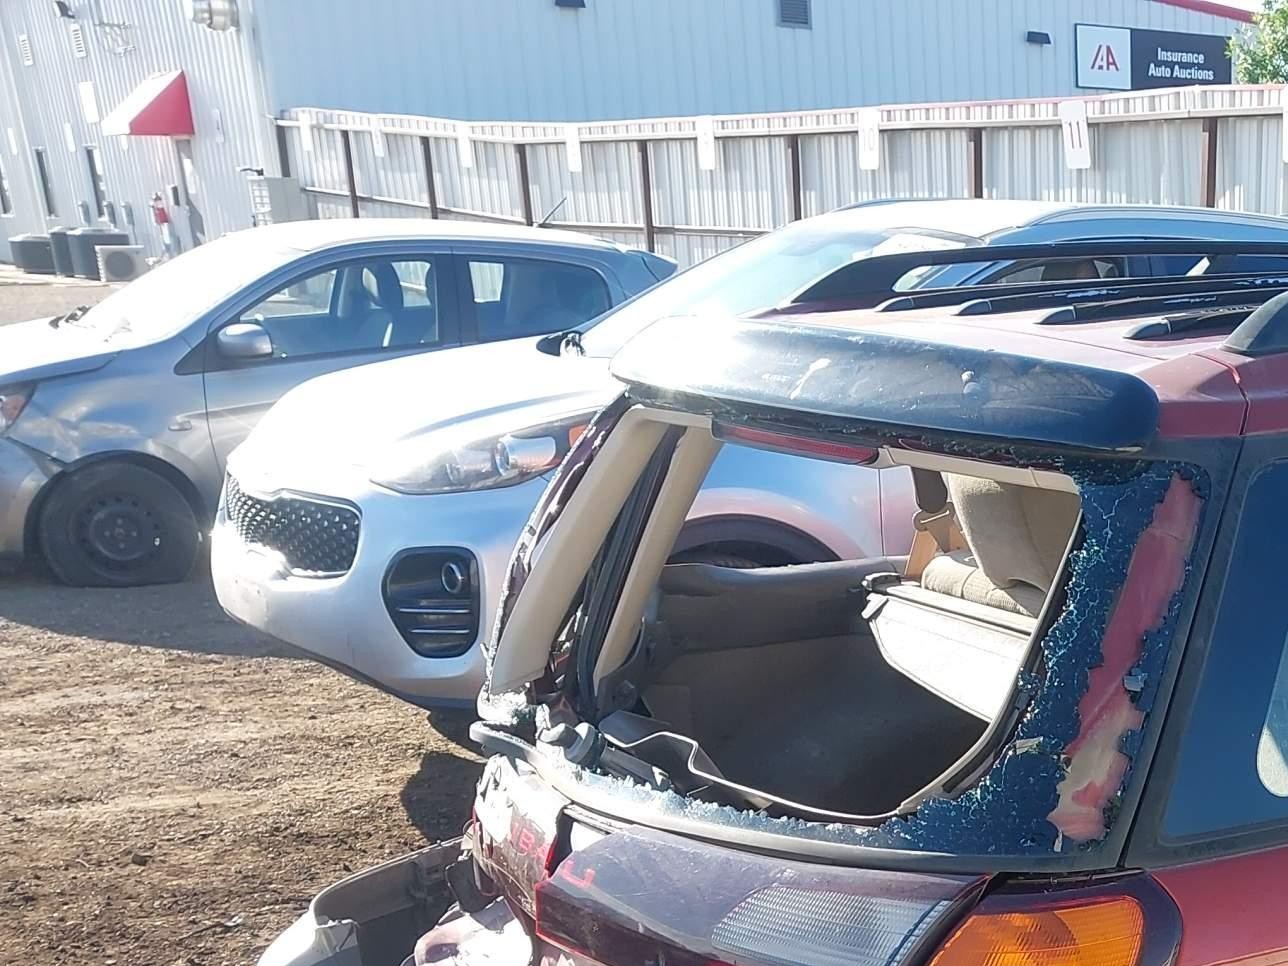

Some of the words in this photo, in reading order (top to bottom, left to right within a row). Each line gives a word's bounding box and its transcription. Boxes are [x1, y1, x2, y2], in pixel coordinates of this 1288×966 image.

[1157, 47, 1204, 64] Insurance
[1148, 63, 1171, 78] Auto
[1173, 65, 1214, 81] Auctions
[1068, 120, 1082, 149] 11
